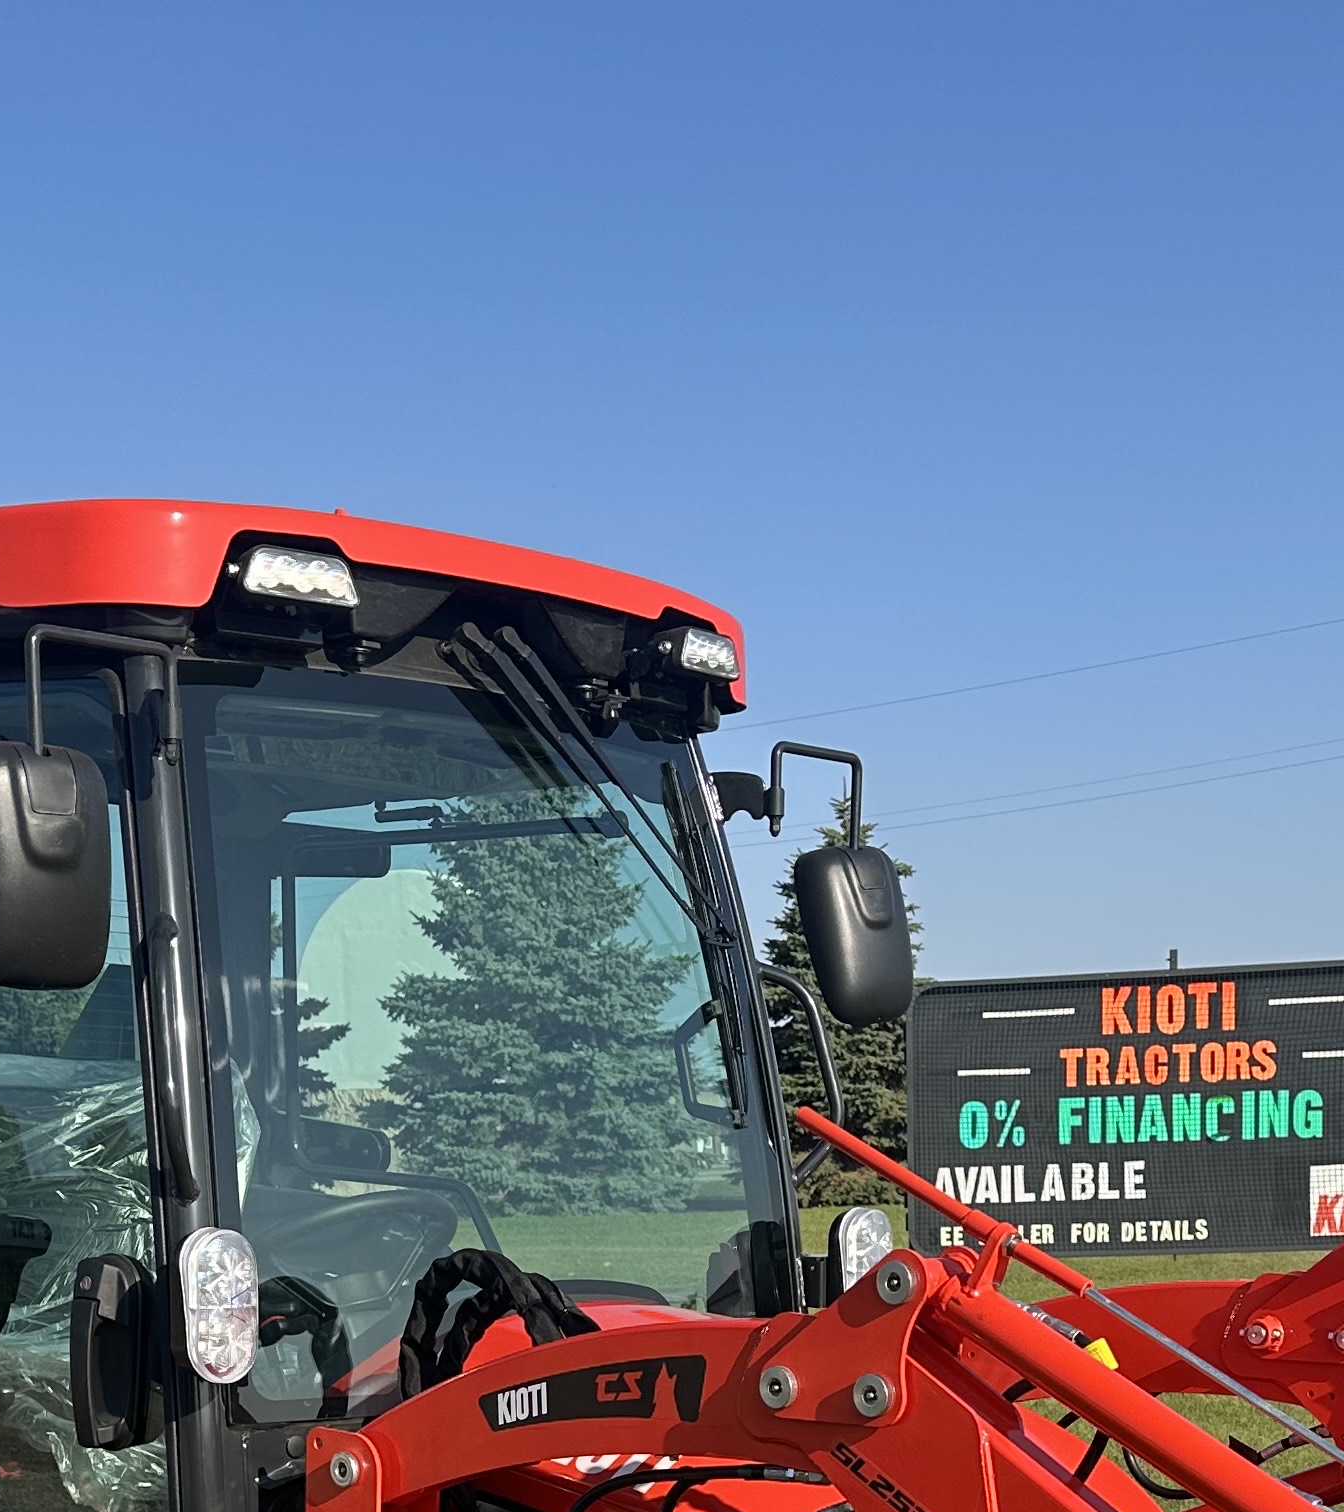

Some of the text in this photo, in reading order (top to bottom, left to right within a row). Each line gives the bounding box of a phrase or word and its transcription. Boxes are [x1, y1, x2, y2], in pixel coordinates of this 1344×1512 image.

[1101, 982, 1236, 1036] KIOTI
[1060, 1040, 1278, 1088] TRACTORS
[959, 1089, 1324, 1149] 0% FINANCING
[935, 1160, 1147, 1204] AVAILABLE
[1071, 1222, 1109, 1243] FOR
[1121, 1219, 1208, 1242] DETAILS
[497, 1371, 643, 1425] KIOTI CS
